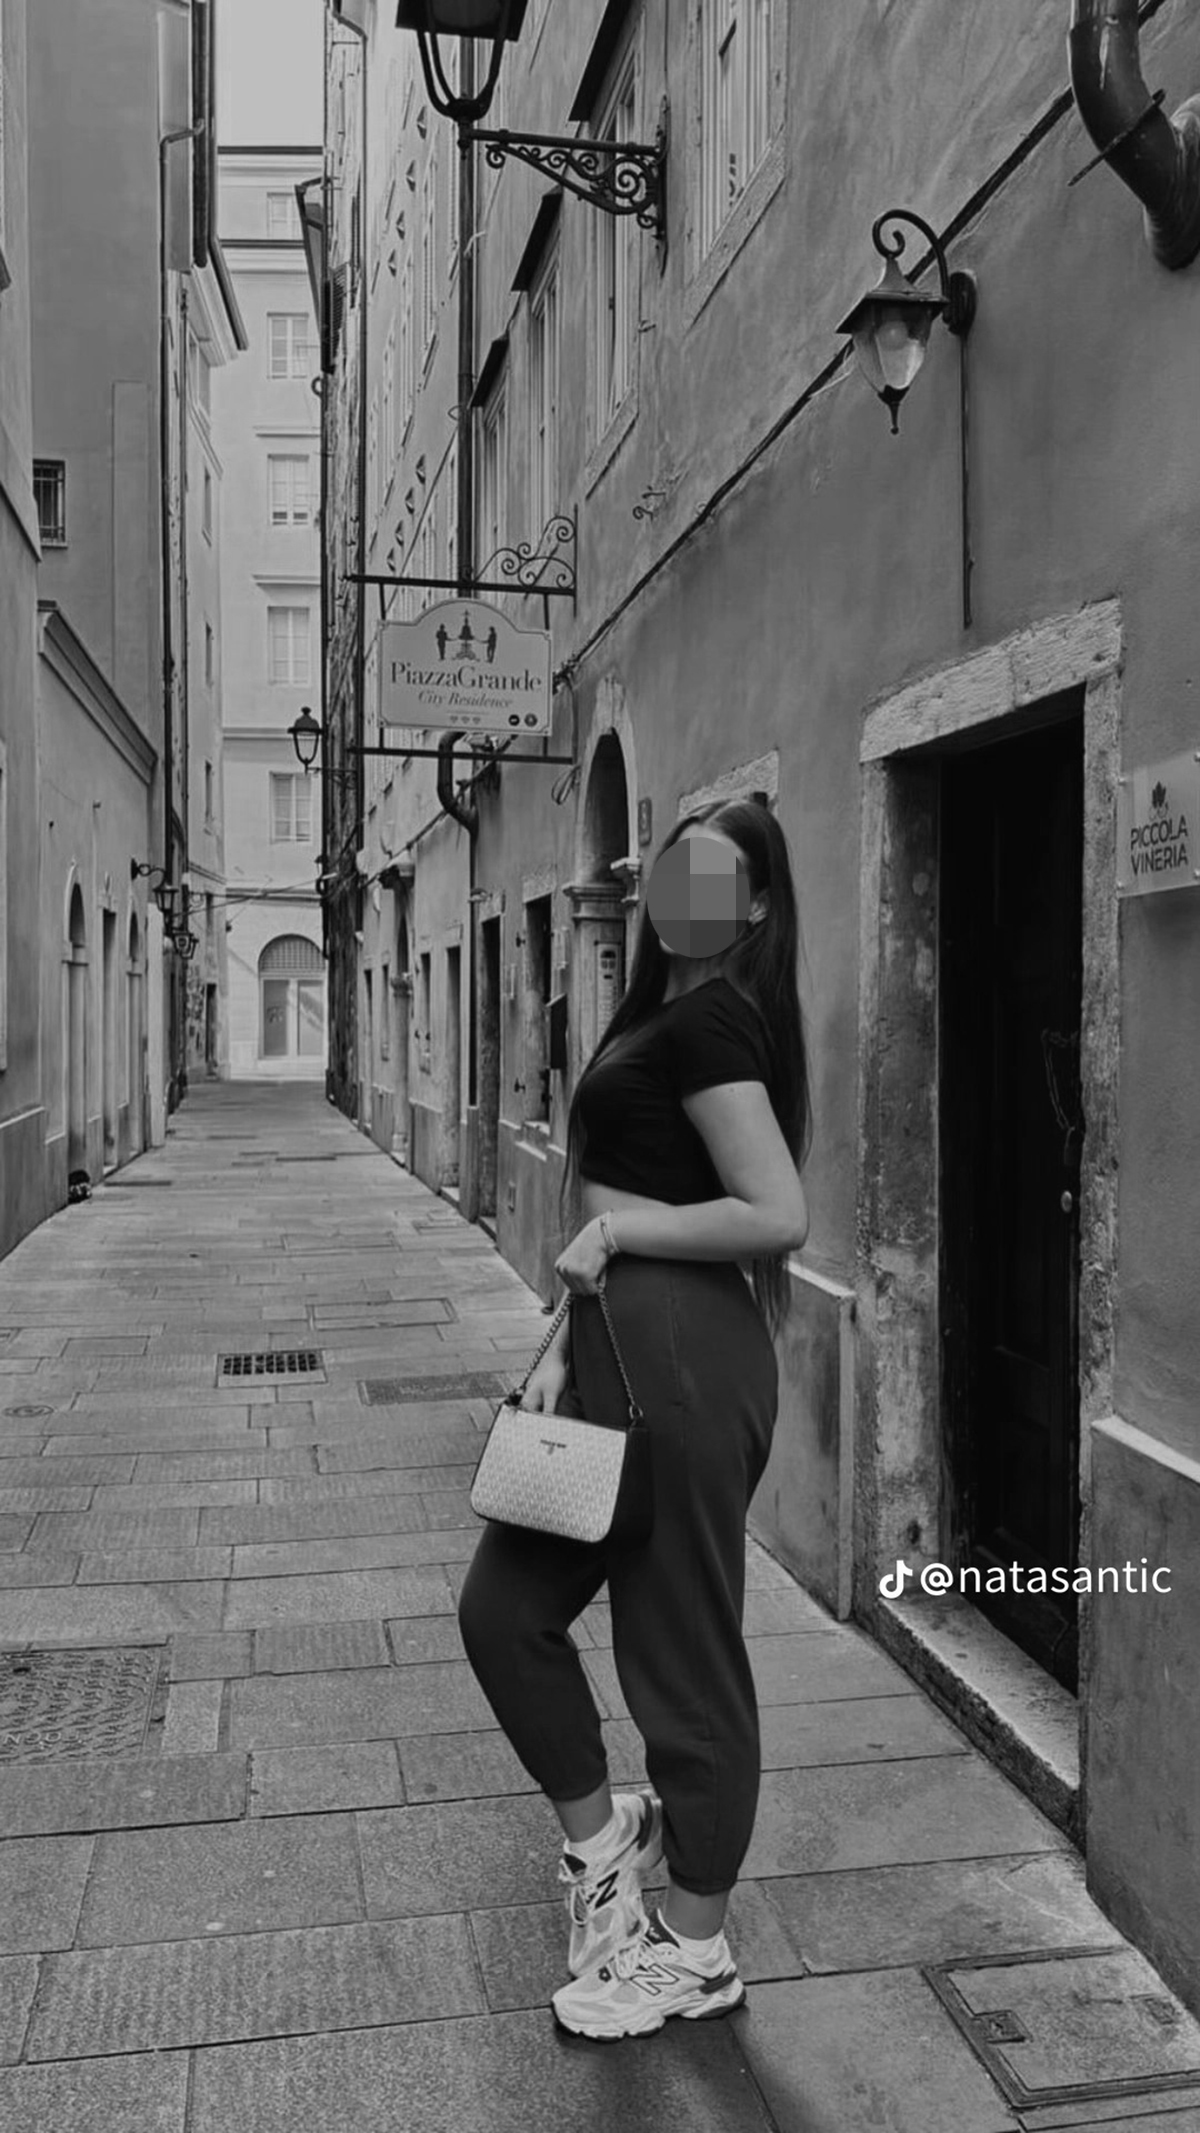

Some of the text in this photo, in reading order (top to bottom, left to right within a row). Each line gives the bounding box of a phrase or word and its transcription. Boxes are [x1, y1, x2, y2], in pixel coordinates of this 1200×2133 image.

[391, 661, 542, 692] PiazzaGrande
[418, 690, 514, 709] City Residence
[1130, 814, 1189, 851] PICCOLA
[1130, 842, 1189, 877] VINERIA
[630, 1962, 680, 1997] N
